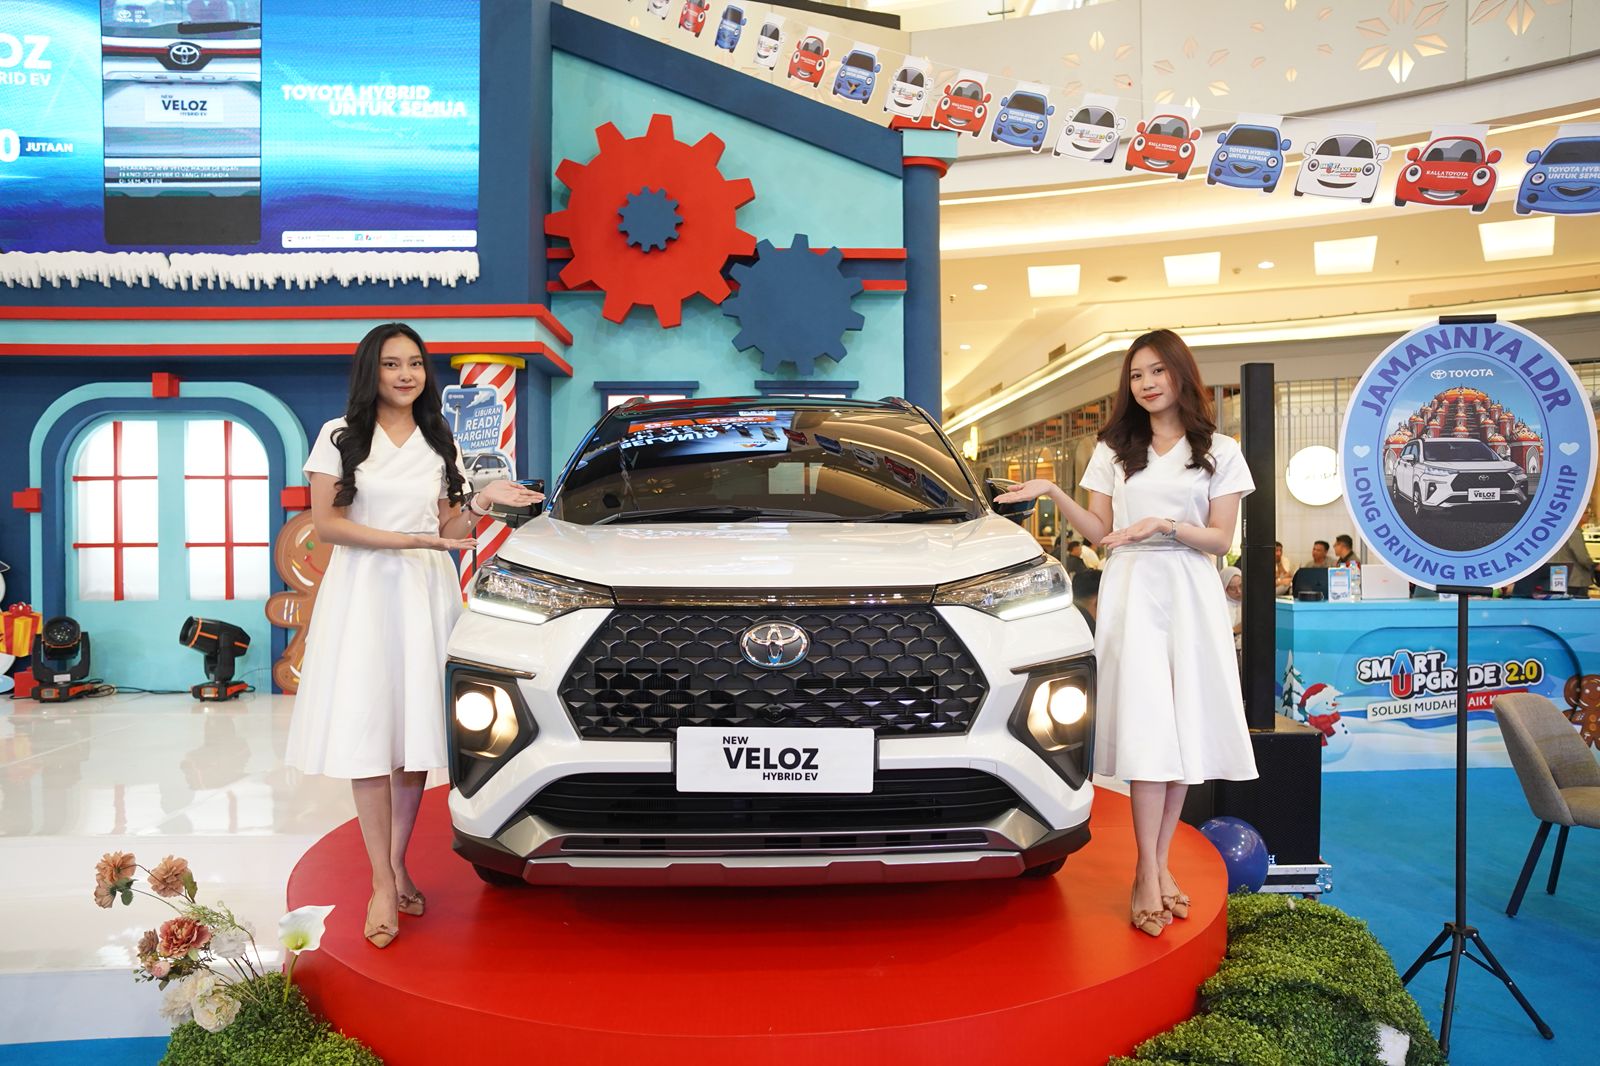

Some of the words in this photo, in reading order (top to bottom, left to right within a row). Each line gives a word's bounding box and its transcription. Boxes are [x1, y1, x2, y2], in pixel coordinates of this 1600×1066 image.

[29, 73, 52, 86] EV
[281, 84, 356, 101] TOYOTA
[359, 84, 430, 101] HYBRID
[162, 100, 207, 111] VELOZ
[329, 100, 396, 116] UNTUK
[399, 101, 467, 118] SEMUA
[25, 142, 74, 153] JUTAAN
[1361, 326, 1523, 417] JAMANNYA
[1518, 353, 1572, 413] LDR
[1449, 368, 1494, 378] TOYOTA
[474, 407, 501, 417] LIBURAN
[465, 414, 500, 431] READY,
[470, 438, 498, 449] MANDIRI
[1353, 466, 1381, 523] LONG
[1374, 523, 1456, 580] DRIVING
[1463, 464, 1578, 580] RELATIONSHIP
[1358, 651, 1442, 682] SMART
[1504, 661, 1540, 684] 2.0
[1372, 703, 1412, 717] SOLUSI
[1414, 699, 1457, 713] MUDAH
[722, 736, 749, 745] NEW
[723, 747, 819, 770] VELOZ
[763, 772, 802, 781] HYBRID
[804, 772, 818, 781] EV
